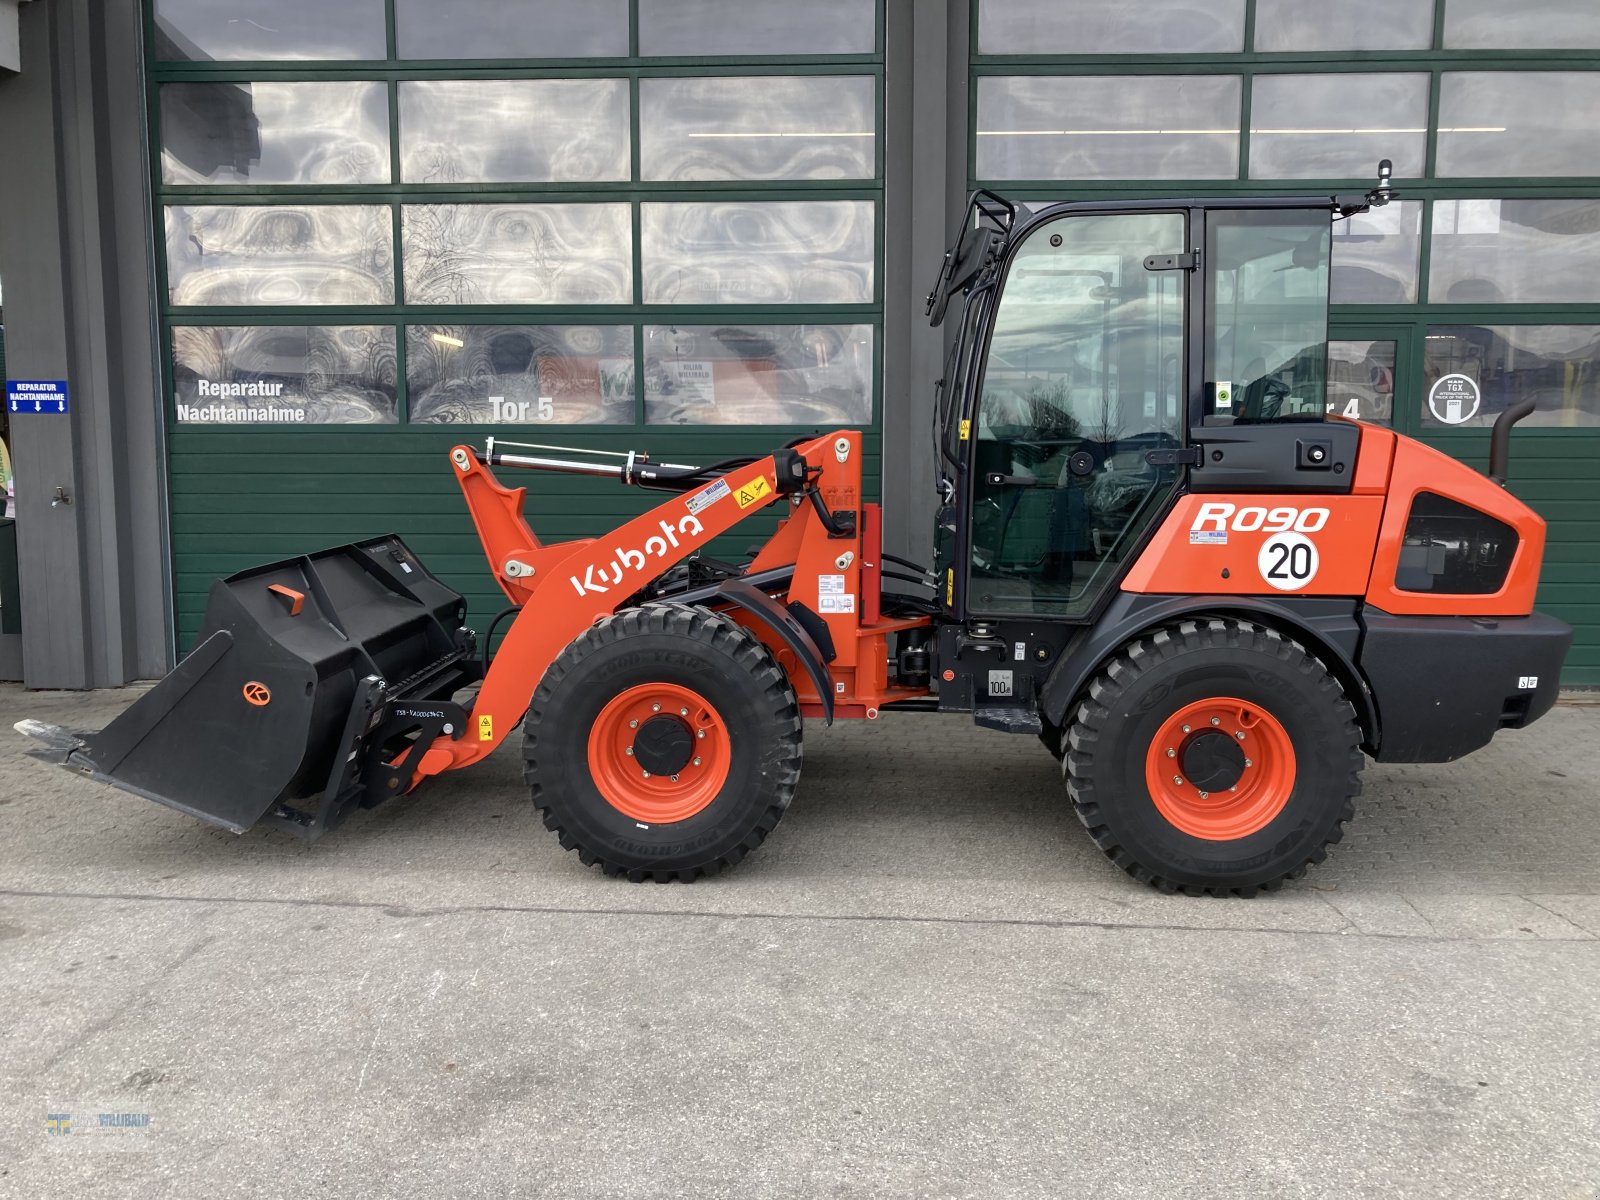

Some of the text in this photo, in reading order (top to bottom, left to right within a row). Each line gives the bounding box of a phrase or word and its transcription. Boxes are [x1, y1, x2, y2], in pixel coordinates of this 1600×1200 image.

[16, 383, 57, 391] REPARATUR
[198, 380, 283, 399] Reparatur
[177, 405, 305, 421] Nachtannahme
[488, 396, 554, 421] Tor 5
[1342, 398, 1360, 420] 4
[569, 514, 705, 597] Kubota
[1267, 542, 1312, 579] 20
[990, 681, 1006, 694] 100
